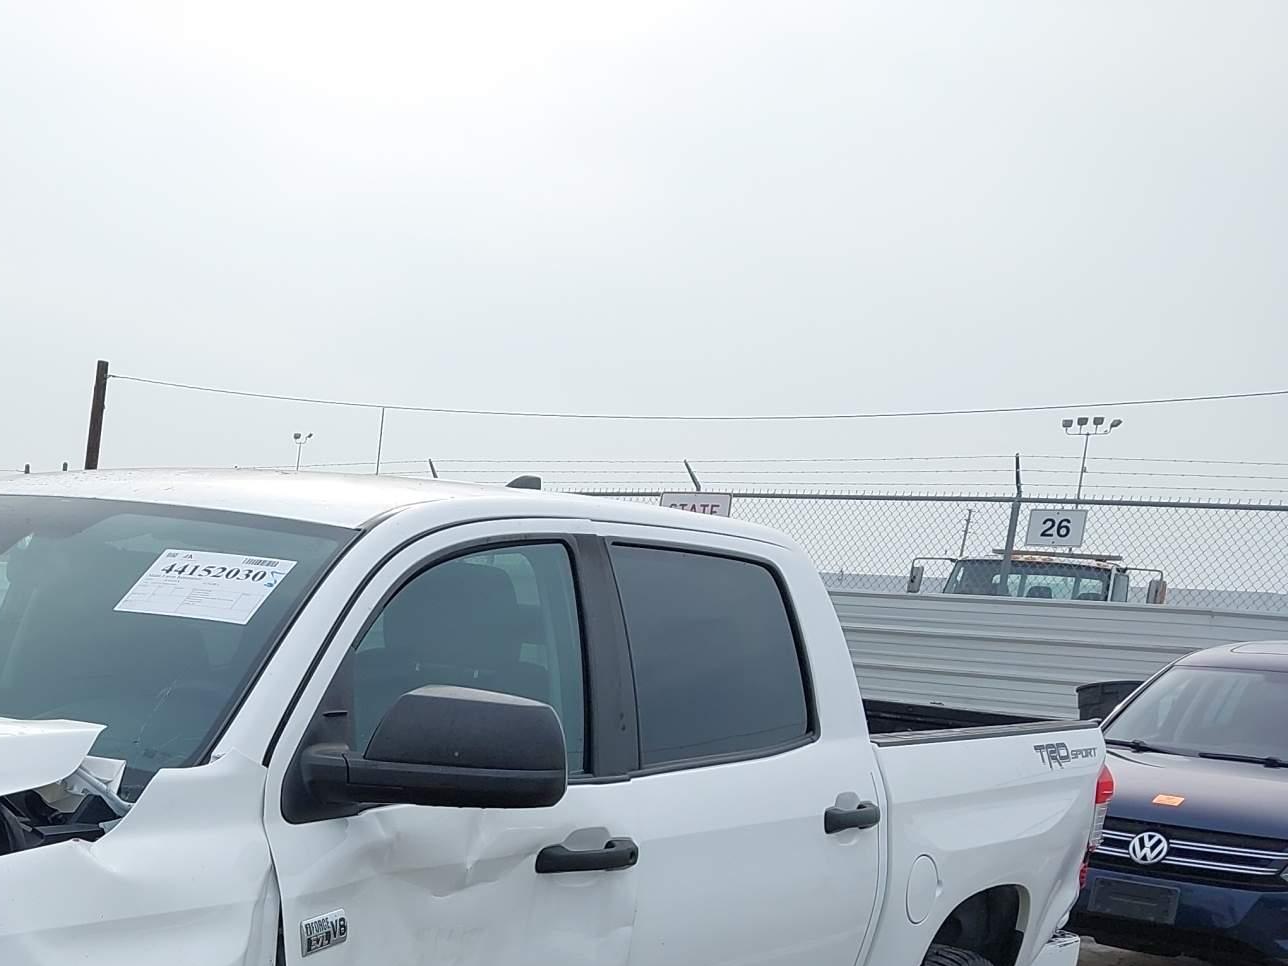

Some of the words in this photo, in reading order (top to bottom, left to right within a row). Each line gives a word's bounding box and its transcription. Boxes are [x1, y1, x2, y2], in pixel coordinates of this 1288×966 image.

[1040, 518, 1072, 538] 26
[161, 562, 267, 583] 44152030
[1033, 742, 1071, 770] TRD
[1071, 747, 1097, 760] SPORT
[330, 917, 346, 938] V8
